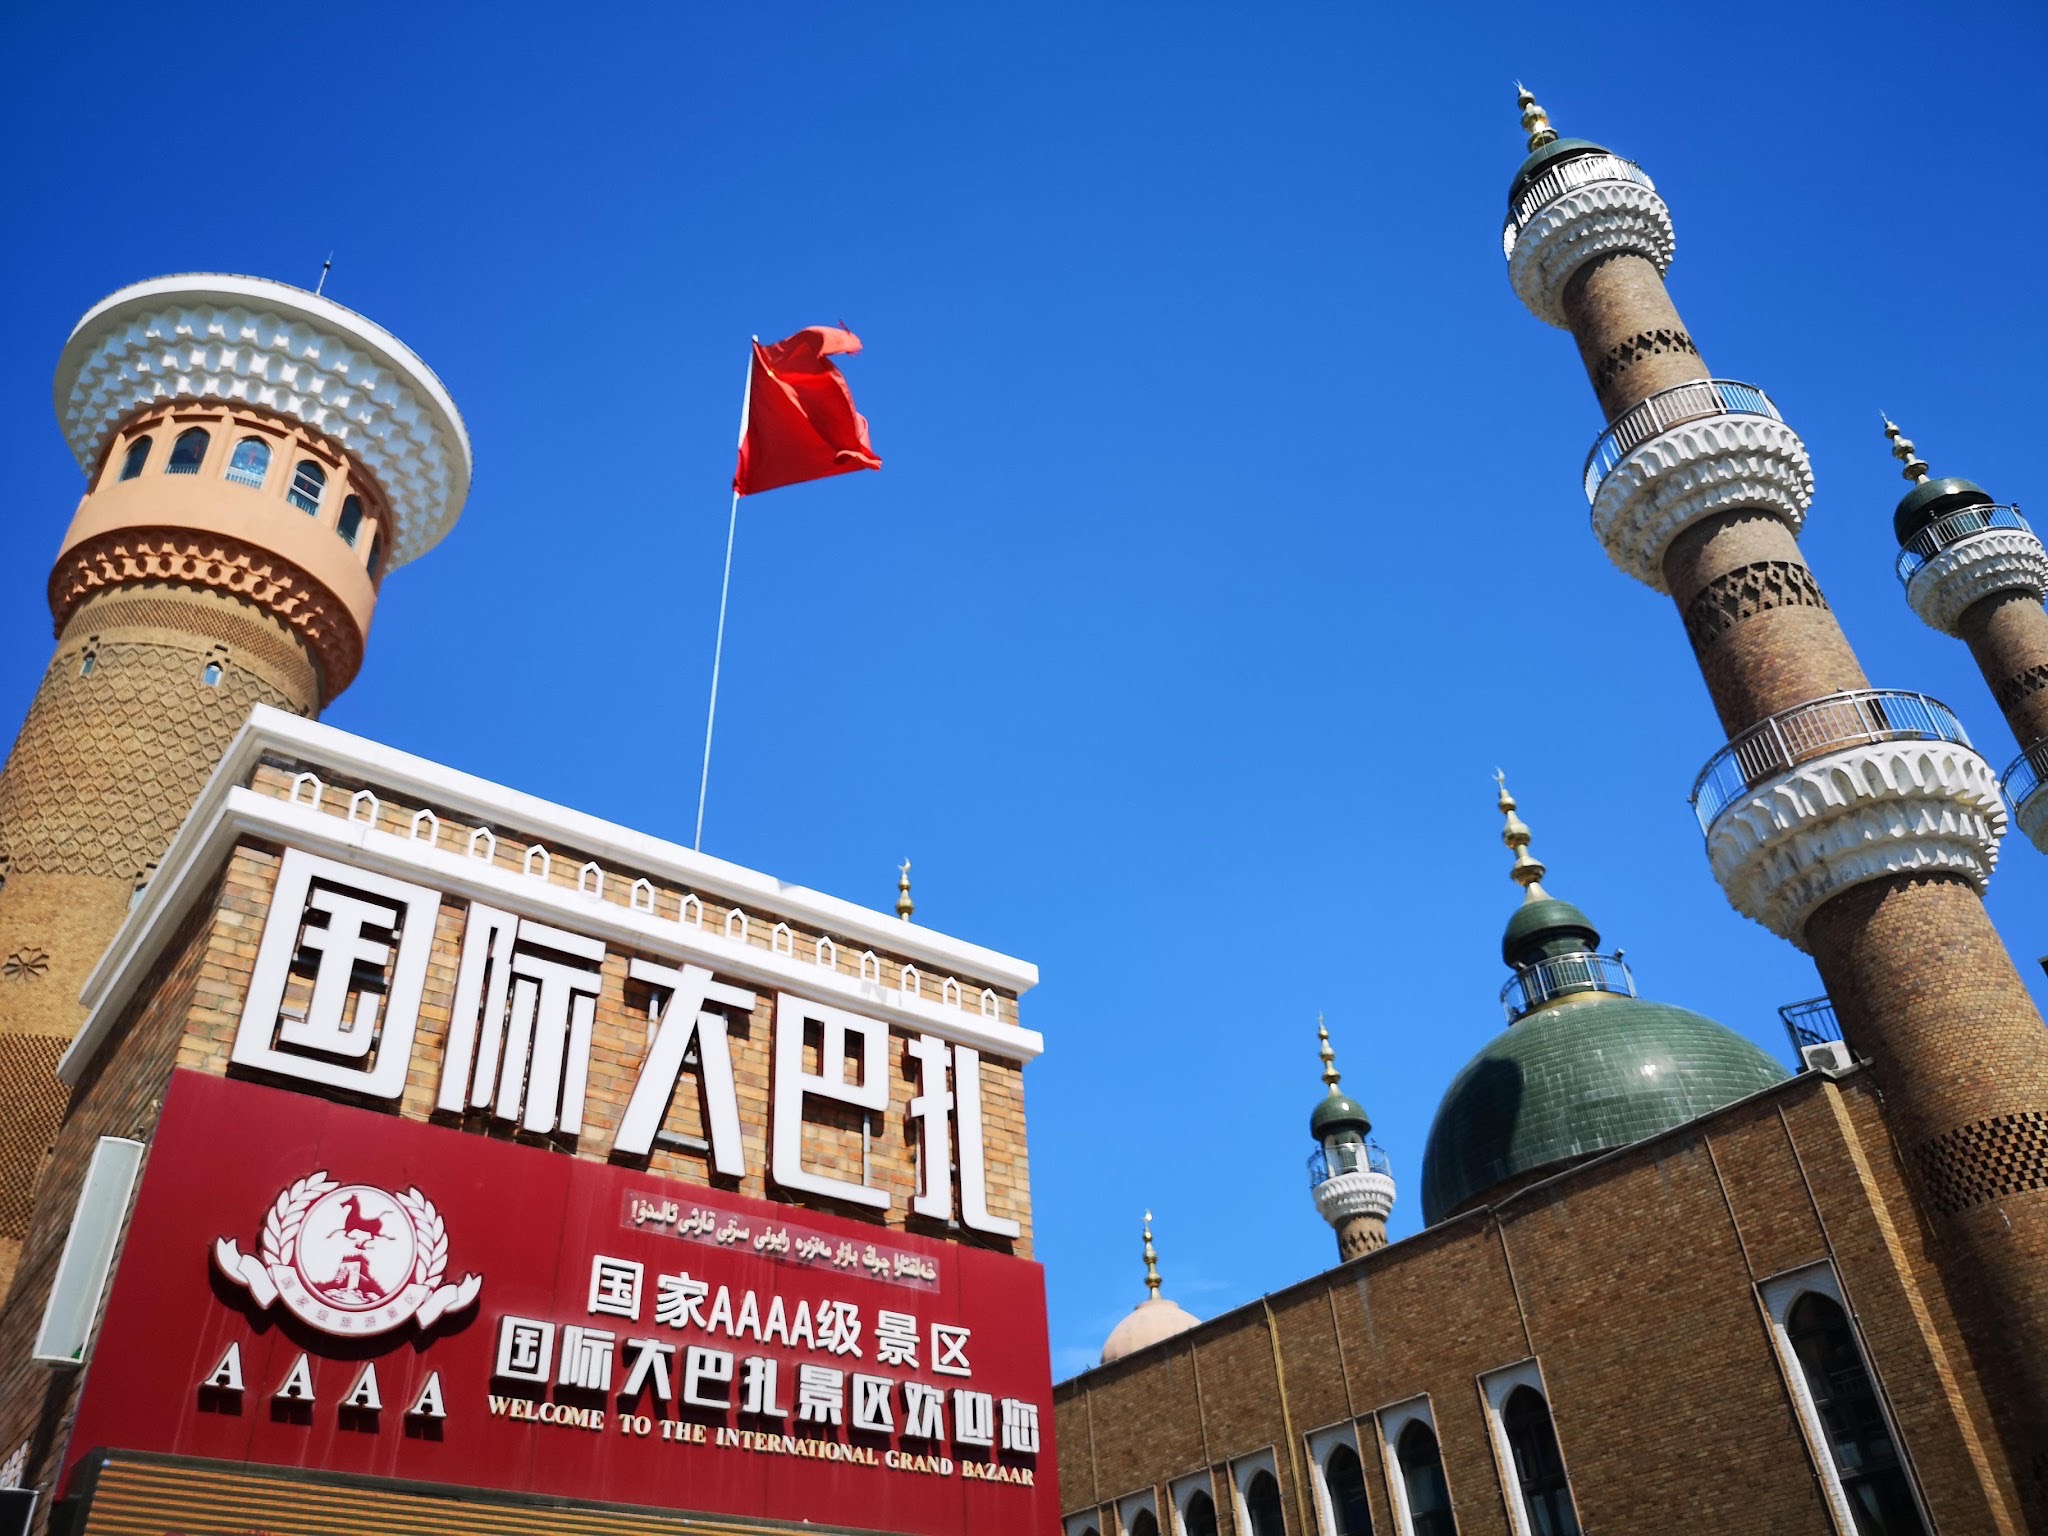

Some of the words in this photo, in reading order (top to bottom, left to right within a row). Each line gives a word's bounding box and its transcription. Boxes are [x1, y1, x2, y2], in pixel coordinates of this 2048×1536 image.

[230, 846, 1021, 1239] 国际大巴扎
[832, 1240, 859, 1268] بازار
[488, 1394, 605, 1430] WELCOME
[618, 1413, 652, 1435] TO
[659, 1419, 707, 1444] THE
[715, 1426, 879, 1467] INTERNATIONAL
[884, 1449, 954, 1475] GRAND
[961, 1459, 1035, 1487] BAZAAR
[494, 1315, 1041, 1454] 国际大巴扎景区欢迎您
